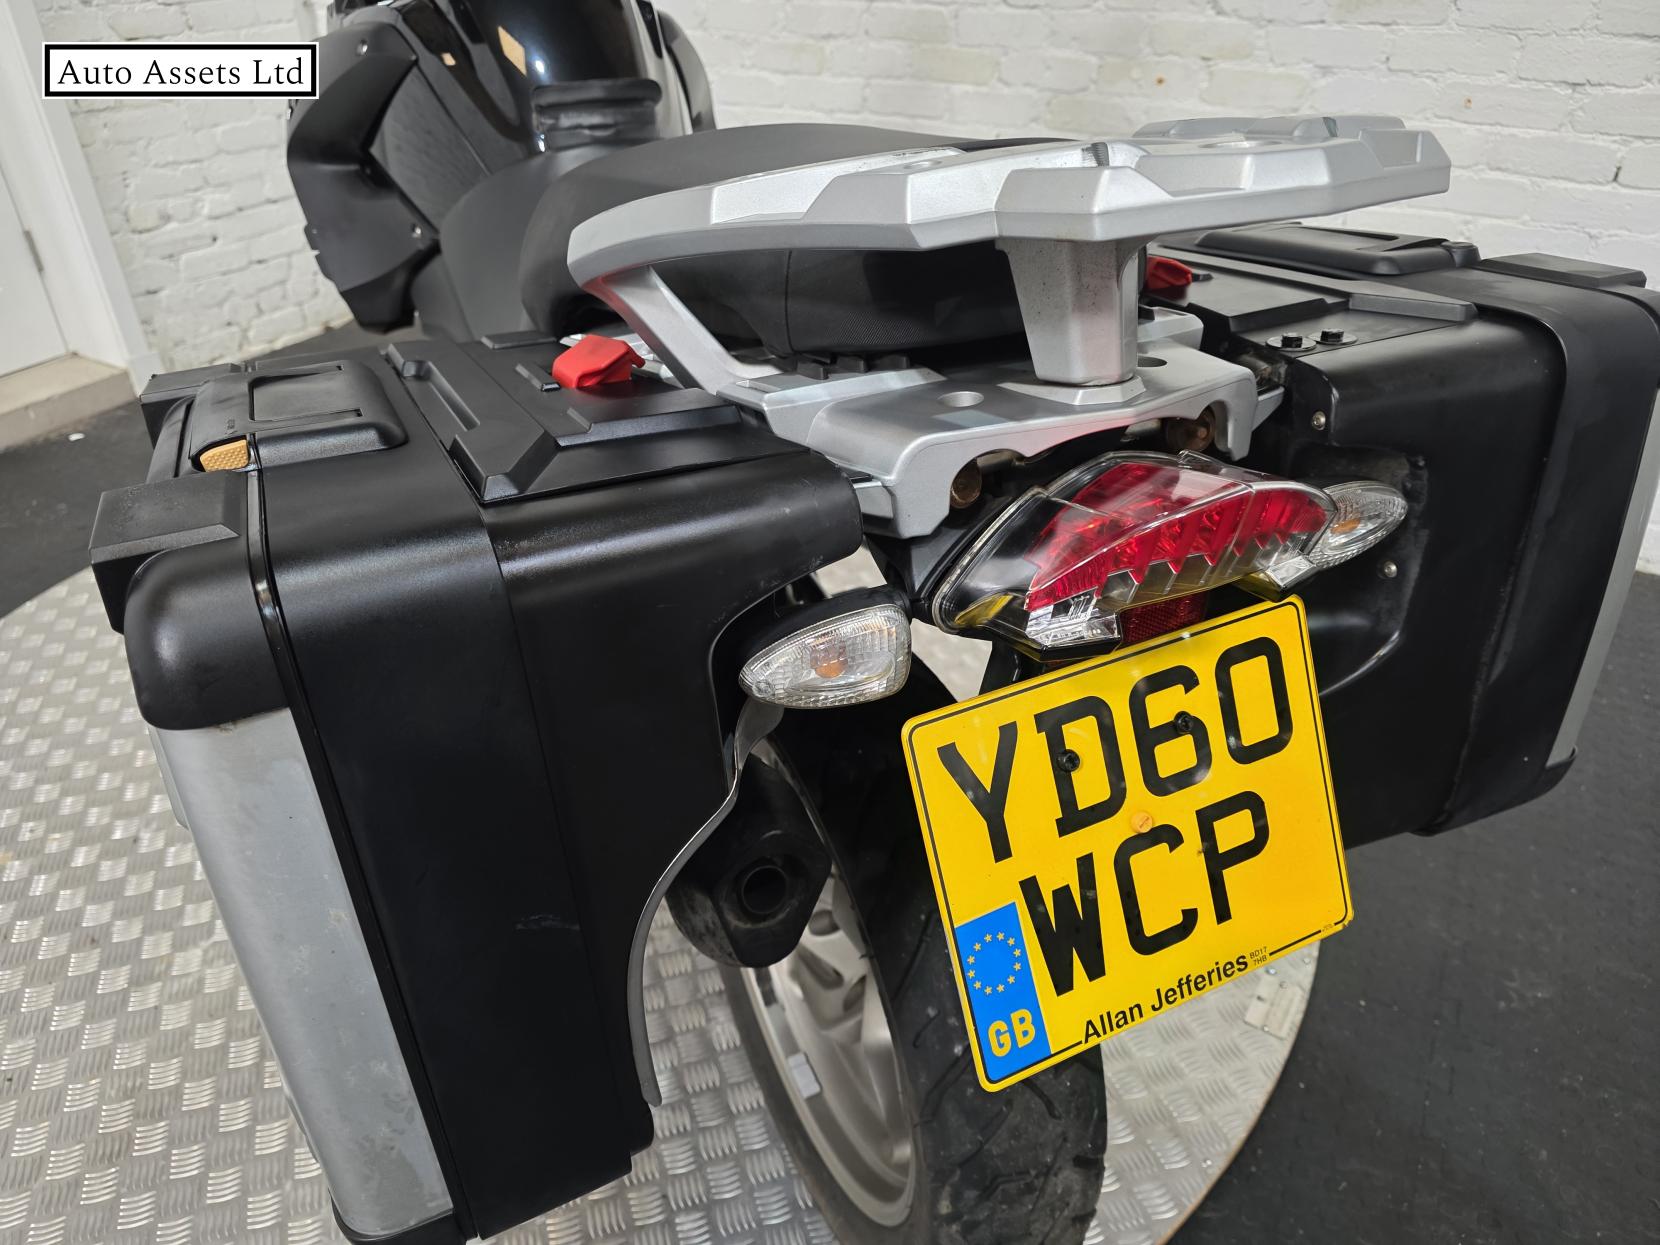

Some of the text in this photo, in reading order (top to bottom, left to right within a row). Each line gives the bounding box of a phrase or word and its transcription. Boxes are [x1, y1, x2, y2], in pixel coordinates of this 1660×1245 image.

[937, 636, 1294, 864] YD60
[1018, 790, 1270, 997] WCP
[1249, 946, 1268, 960] BD17
[987, 1008, 1036, 1057] GB
[1083, 954, 1249, 1044] Allan Jefferies
